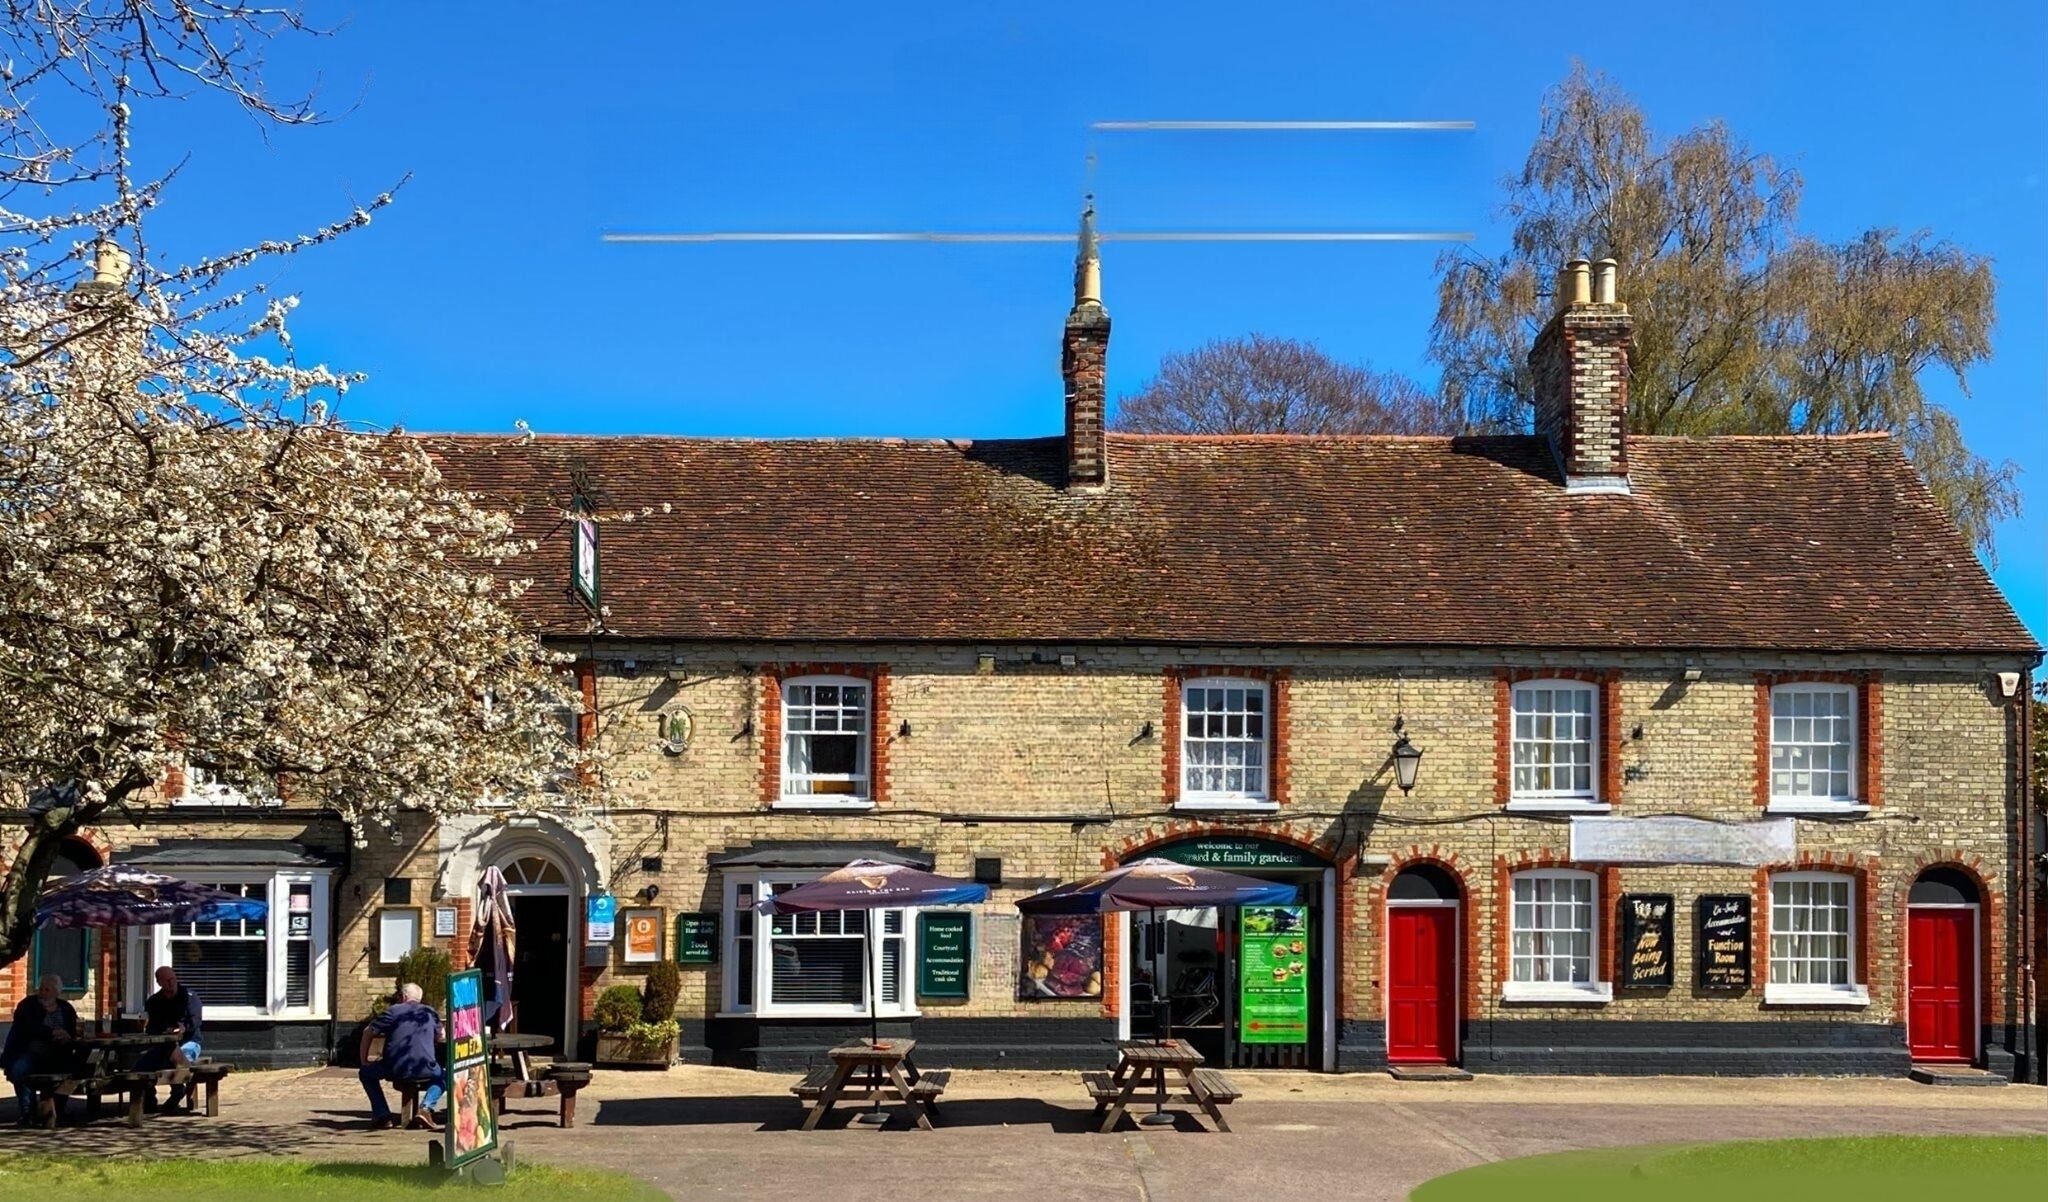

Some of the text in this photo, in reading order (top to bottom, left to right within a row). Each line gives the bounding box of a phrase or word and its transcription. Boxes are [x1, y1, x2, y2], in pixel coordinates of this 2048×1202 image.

[1197, 842, 1233, 850] welcome
[1212, 852, 1221, 863] &
[1223, 851, 1256, 864] family
[1708, 939, 1744, 952] Function
[1632, 949, 1663, 965] Being
[1715, 952, 1736, 963] Room
[1632, 961, 1667, 980] Served
